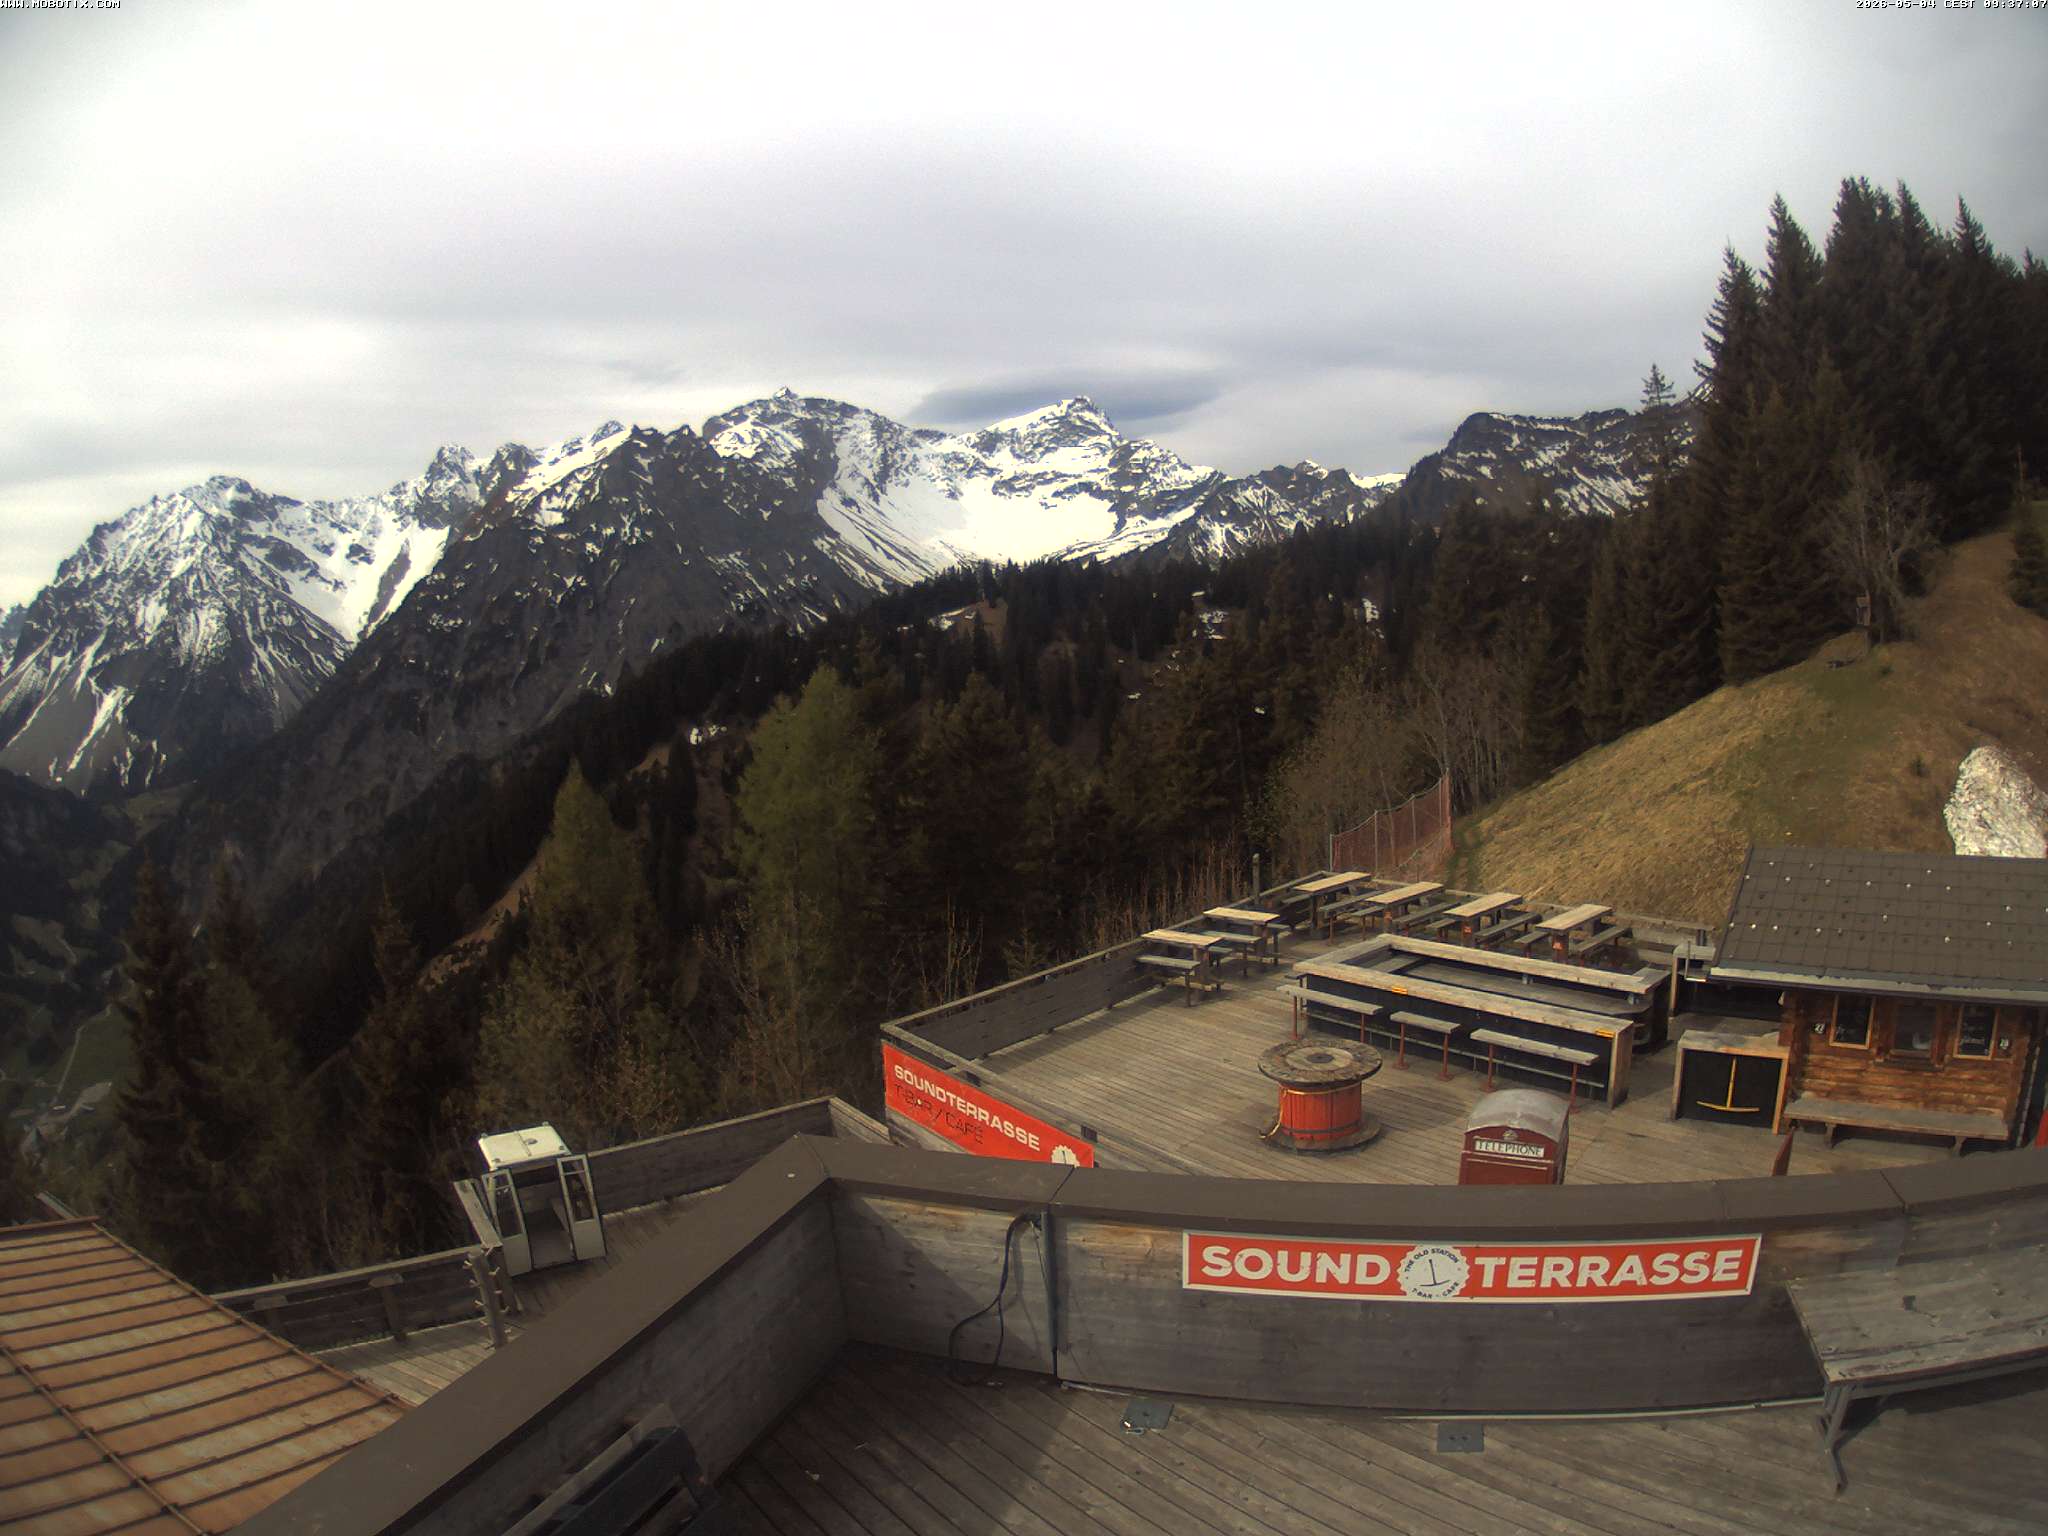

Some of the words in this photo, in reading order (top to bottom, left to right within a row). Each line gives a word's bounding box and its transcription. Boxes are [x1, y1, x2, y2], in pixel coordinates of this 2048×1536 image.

[894, 1064, 1041, 1152] SOUNDTERRASSE
[1478, 1140, 1541, 1157] TELEPHONE
[1201, 1245, 1391, 1285] SOUND
[1404, 1259, 1415, 1272] THE
[1414, 1248, 1429, 1260] OLD
[1431, 1247, 1459, 1263] STATION
[1475, 1249, 1744, 1288] TERRASSE
